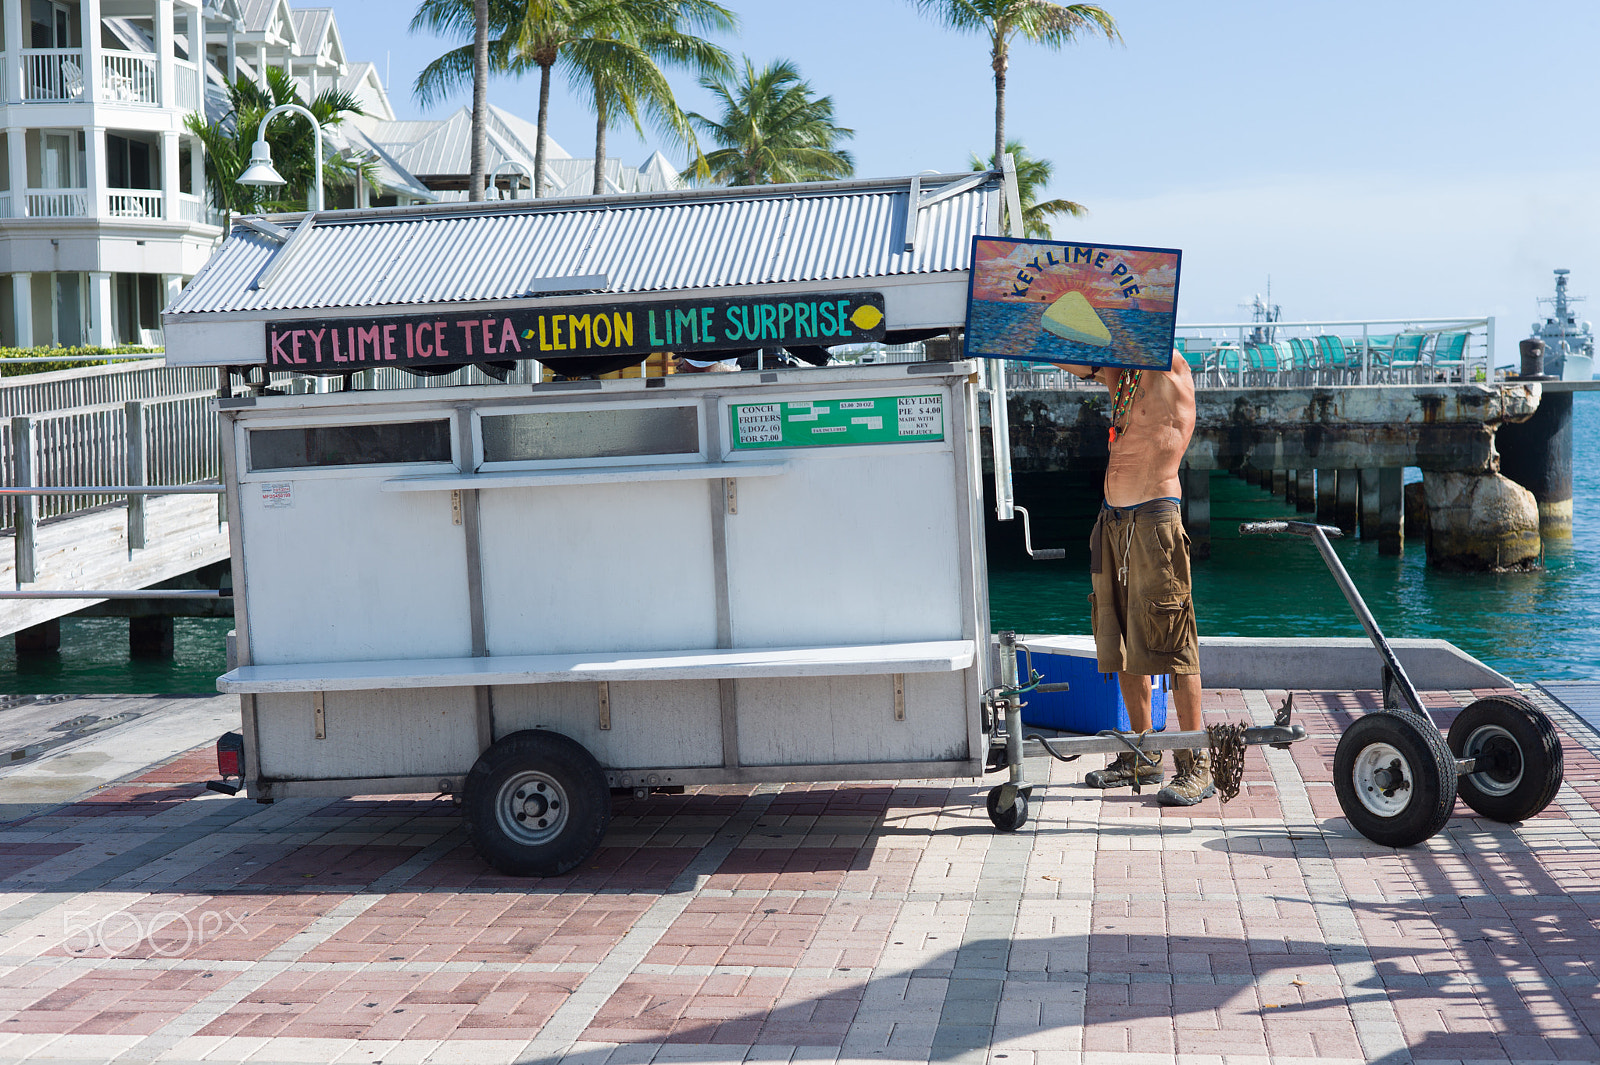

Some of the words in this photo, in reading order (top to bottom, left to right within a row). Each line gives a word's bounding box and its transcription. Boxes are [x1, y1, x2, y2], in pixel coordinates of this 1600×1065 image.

[1111, 263, 1141, 299] PIE
[405, 321, 449, 358] ICE
[457, 317, 522, 355] TEA
[538, 311, 634, 351] LEMON
[648, 307, 716, 346] LIME
[725, 300, 852, 341] SURPRISE
[898, 398, 916, 406] KEY
[919, 397, 942, 405] LIME
[742, 405, 774, 414] CONCH
[898, 407, 913, 415] PIE
[739, 415, 781, 423] FRITTERS
[770, 424, 780, 433] (6)
[740, 435, 758, 443] FOR
[759, 434, 779, 442] $7.00
